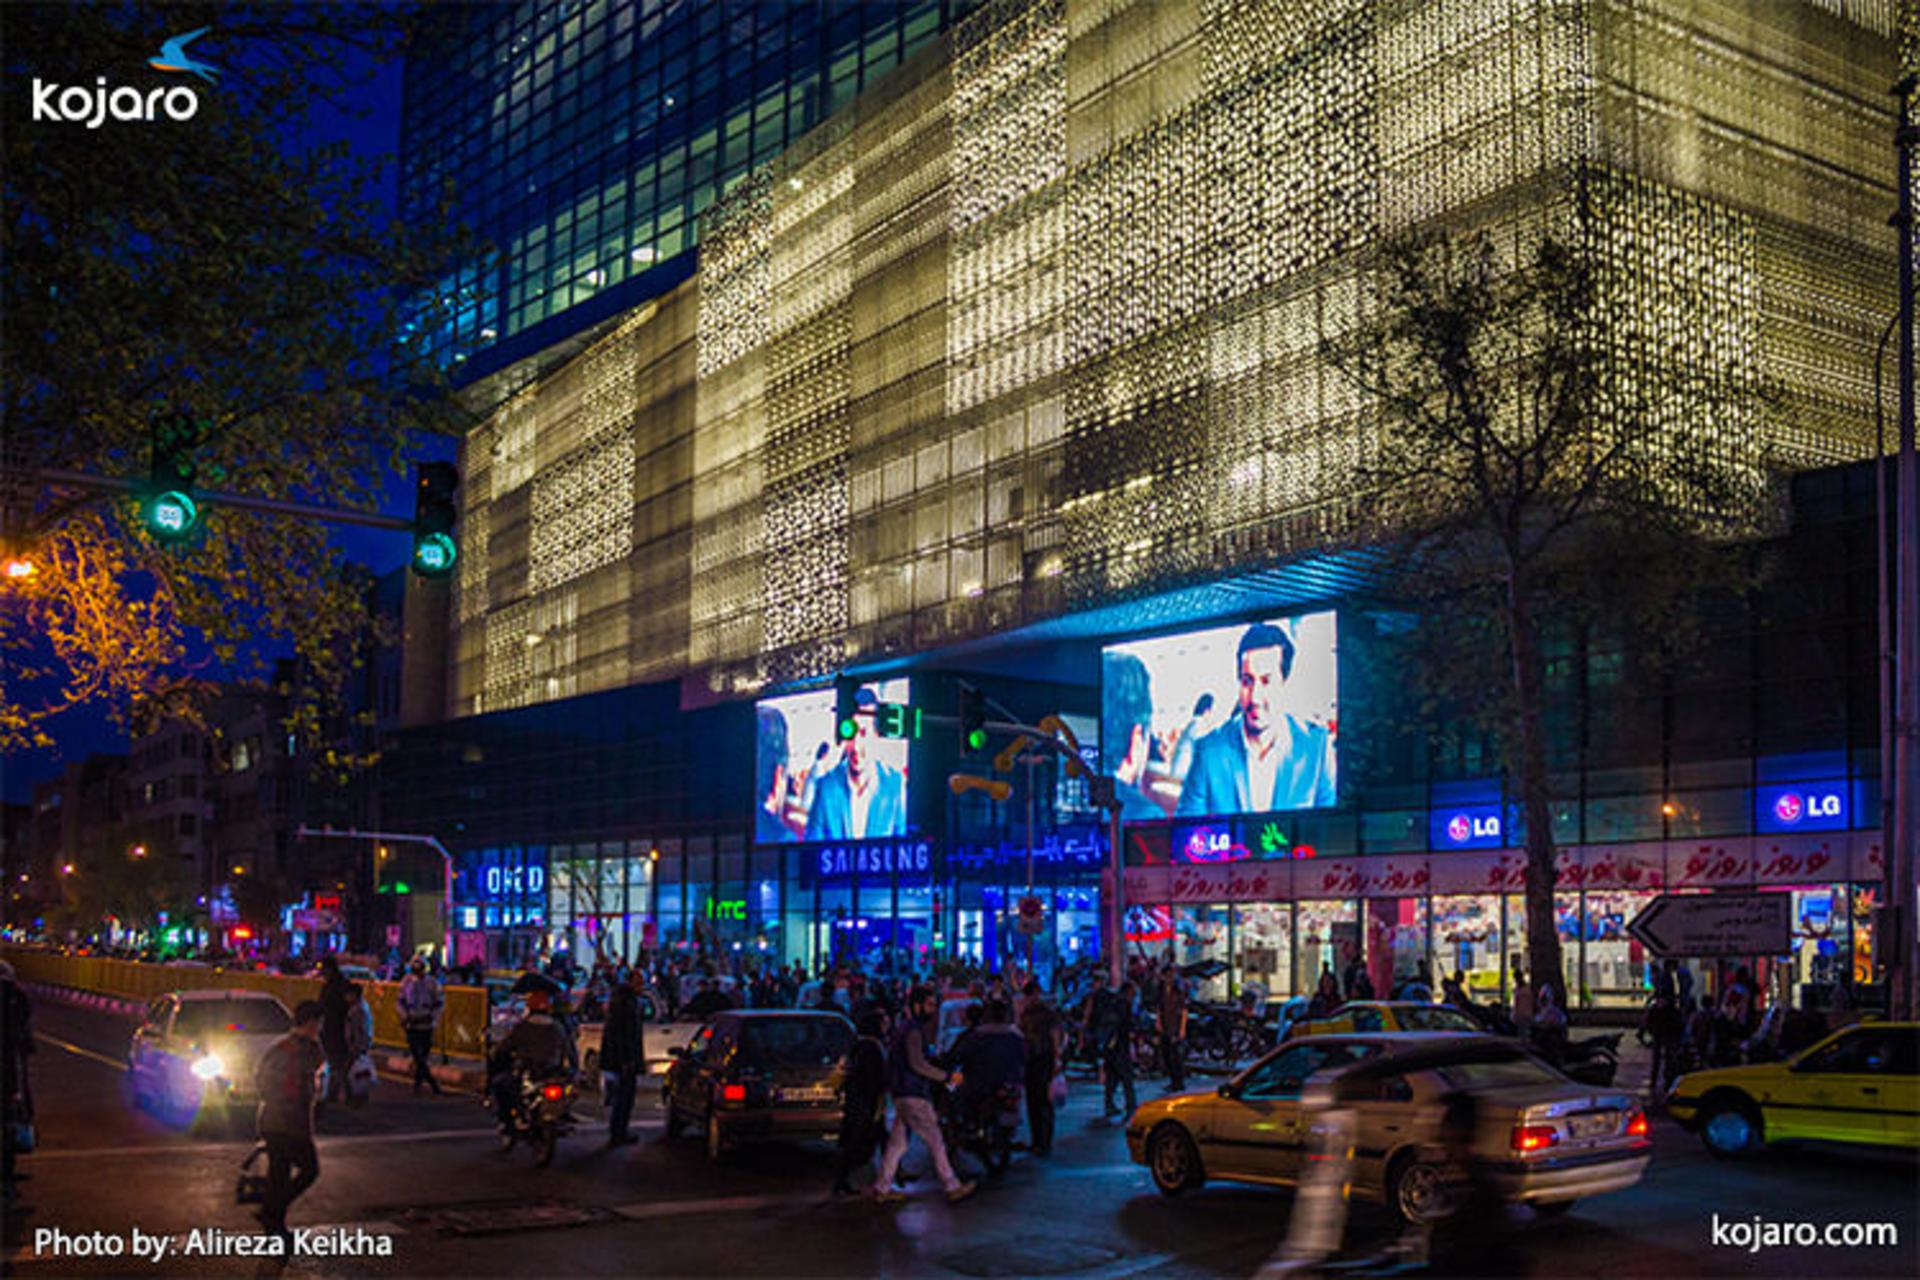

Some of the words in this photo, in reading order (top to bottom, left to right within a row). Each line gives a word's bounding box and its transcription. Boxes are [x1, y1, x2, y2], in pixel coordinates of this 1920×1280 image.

[1808, 795, 1840, 817] LG
[1474, 816, 1500, 837] LG
[1210, 834, 1230, 851] LG
